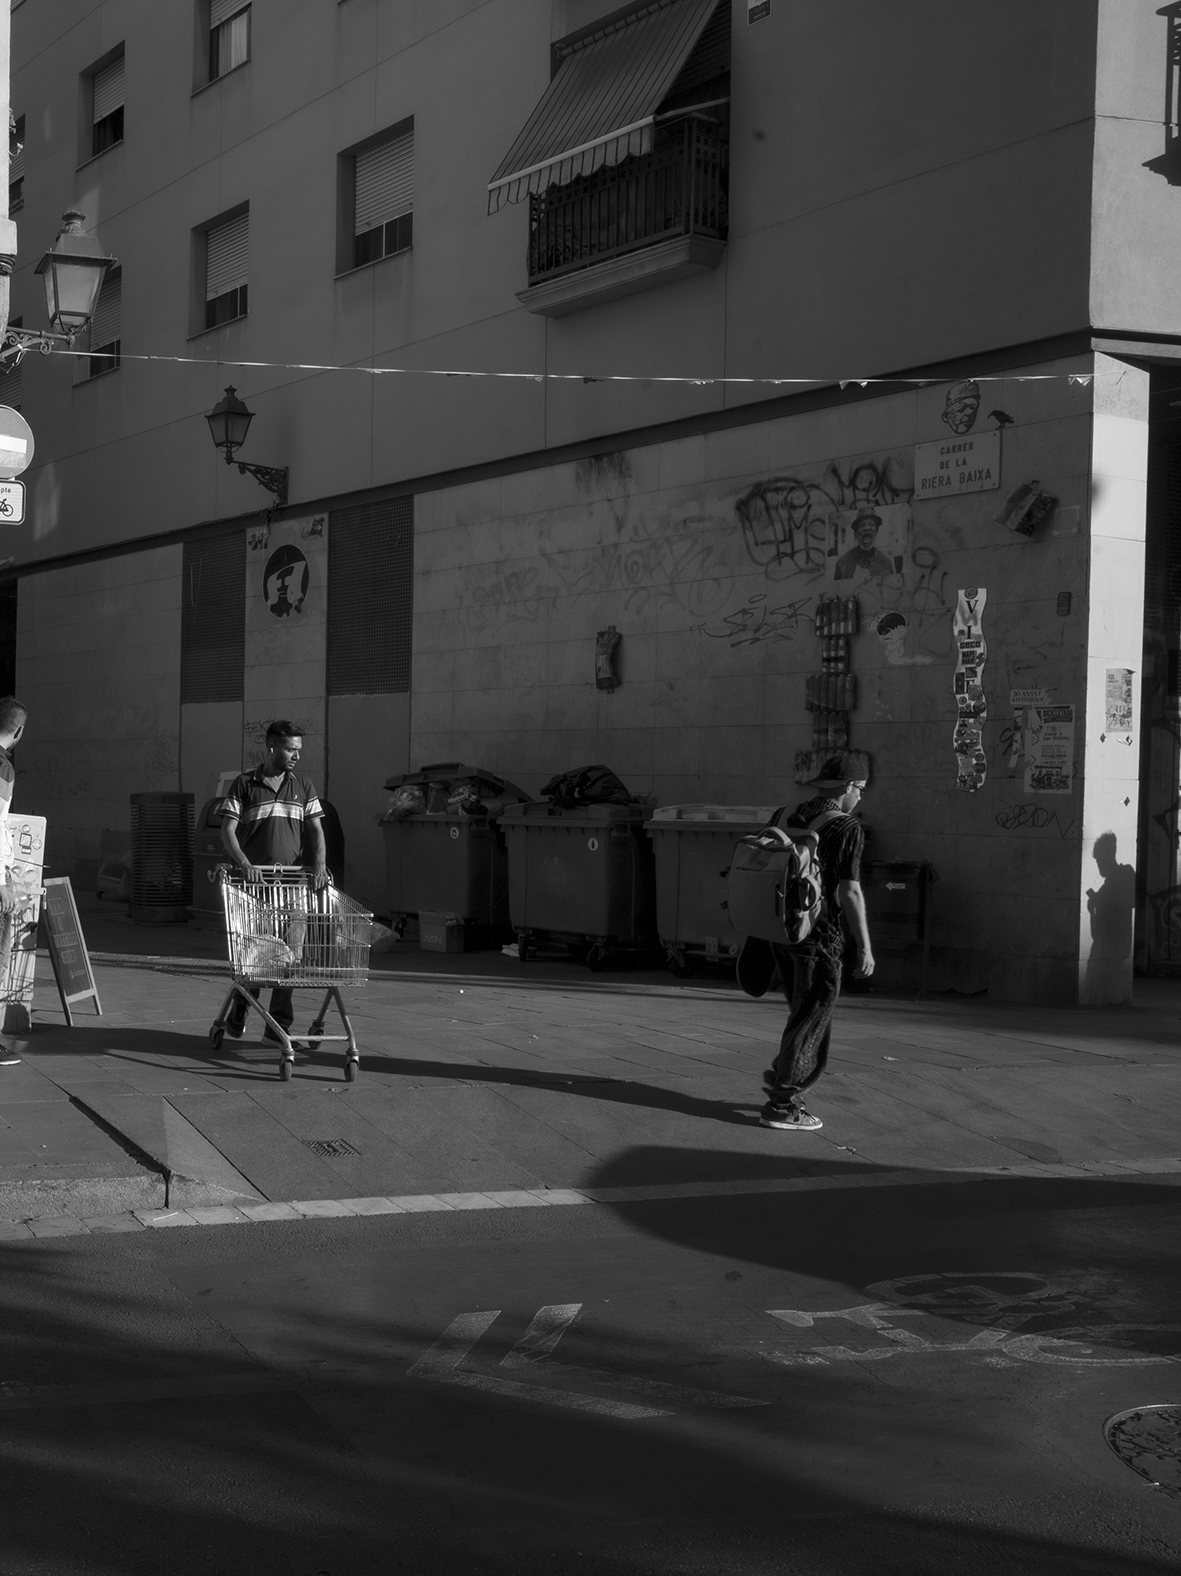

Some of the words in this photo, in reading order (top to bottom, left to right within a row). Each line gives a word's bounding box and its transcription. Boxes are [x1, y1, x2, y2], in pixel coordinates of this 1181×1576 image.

[940, 442, 974, 456] CARRER
[939, 460, 950, 470] DE
[956, 458, 967, 467] LA
[921, 475, 952, 490] RIERA
[959, 468, 992, 485] BAIXA
